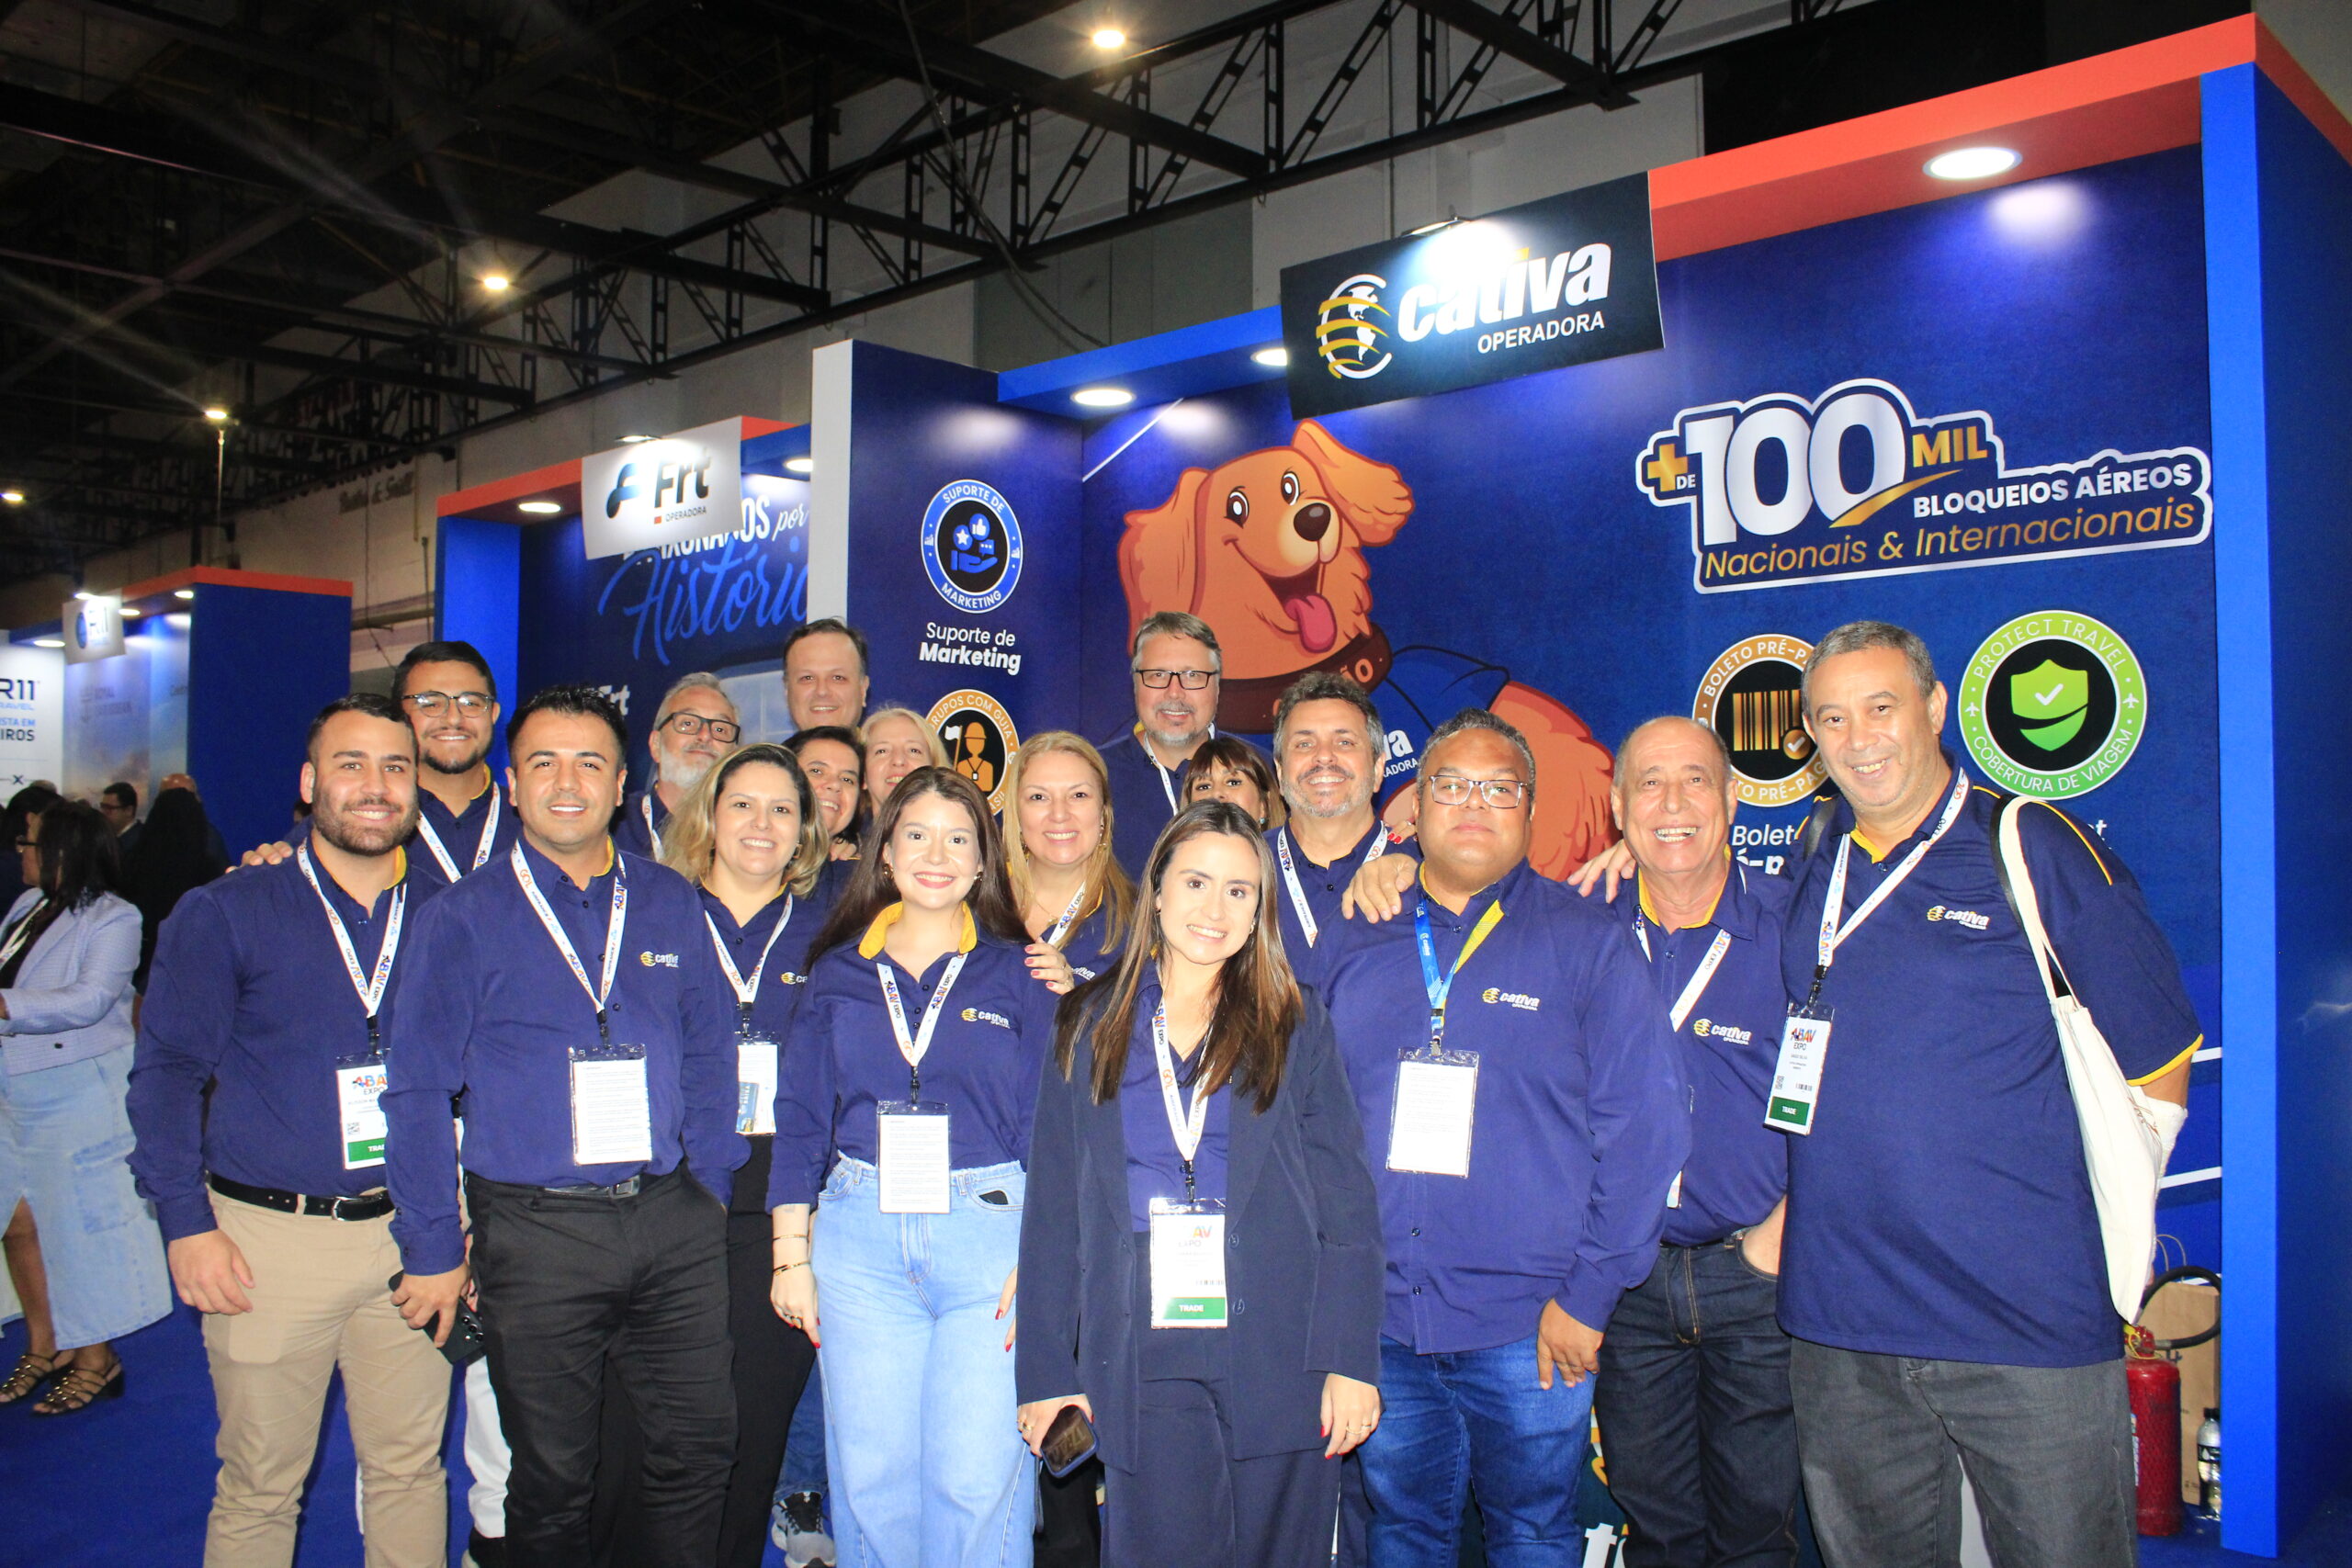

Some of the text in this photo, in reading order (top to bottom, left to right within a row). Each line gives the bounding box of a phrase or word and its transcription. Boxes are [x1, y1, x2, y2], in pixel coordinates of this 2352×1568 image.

[1397, 243, 1611, 343] cativa
[1477, 310, 1604, 354] OPERADORA
[1912, 426, 1987, 468] MIL
[1676, 474, 1696, 491] DE
[1685, 394, 1905, 546] 100
[942, 485, 1005, 513] SUPORTE DE
[1914, 463, 2192, 518] BLOQUEIOS AÉREOS
[665, 506, 707, 522] OPERADORA
[772, 502, 809, 542] por
[1706, 497, 2195, 579] Nacionais & Internacionais
[941, 582, 1002, 609] MARKETING
[926, 622, 1016, 647] Suporte de
[1973, 619, 2127, 679] PROTECT TRAVEL
[919, 642, 1022, 675] Marketing
[1703, 646, 1753, 697] BOLETO
[931, 694, 1012, 739] RUPOS COM GUIA
[1974, 728, 2132, 792] COBERTURA DE VIAGEM
[1758, 761, 1826, 801] PRÉ-PAG
[1732, 824, 1795, 846] Bolet
[1944, 908, 1990, 928] cativa
[1499, 991, 1540, 1008] cativa
[978, 1010, 1010, 1026] cativa
[1711, 1024, 1752, 1042] cativa
[1179, 1304, 1204, 1313] TRADE
